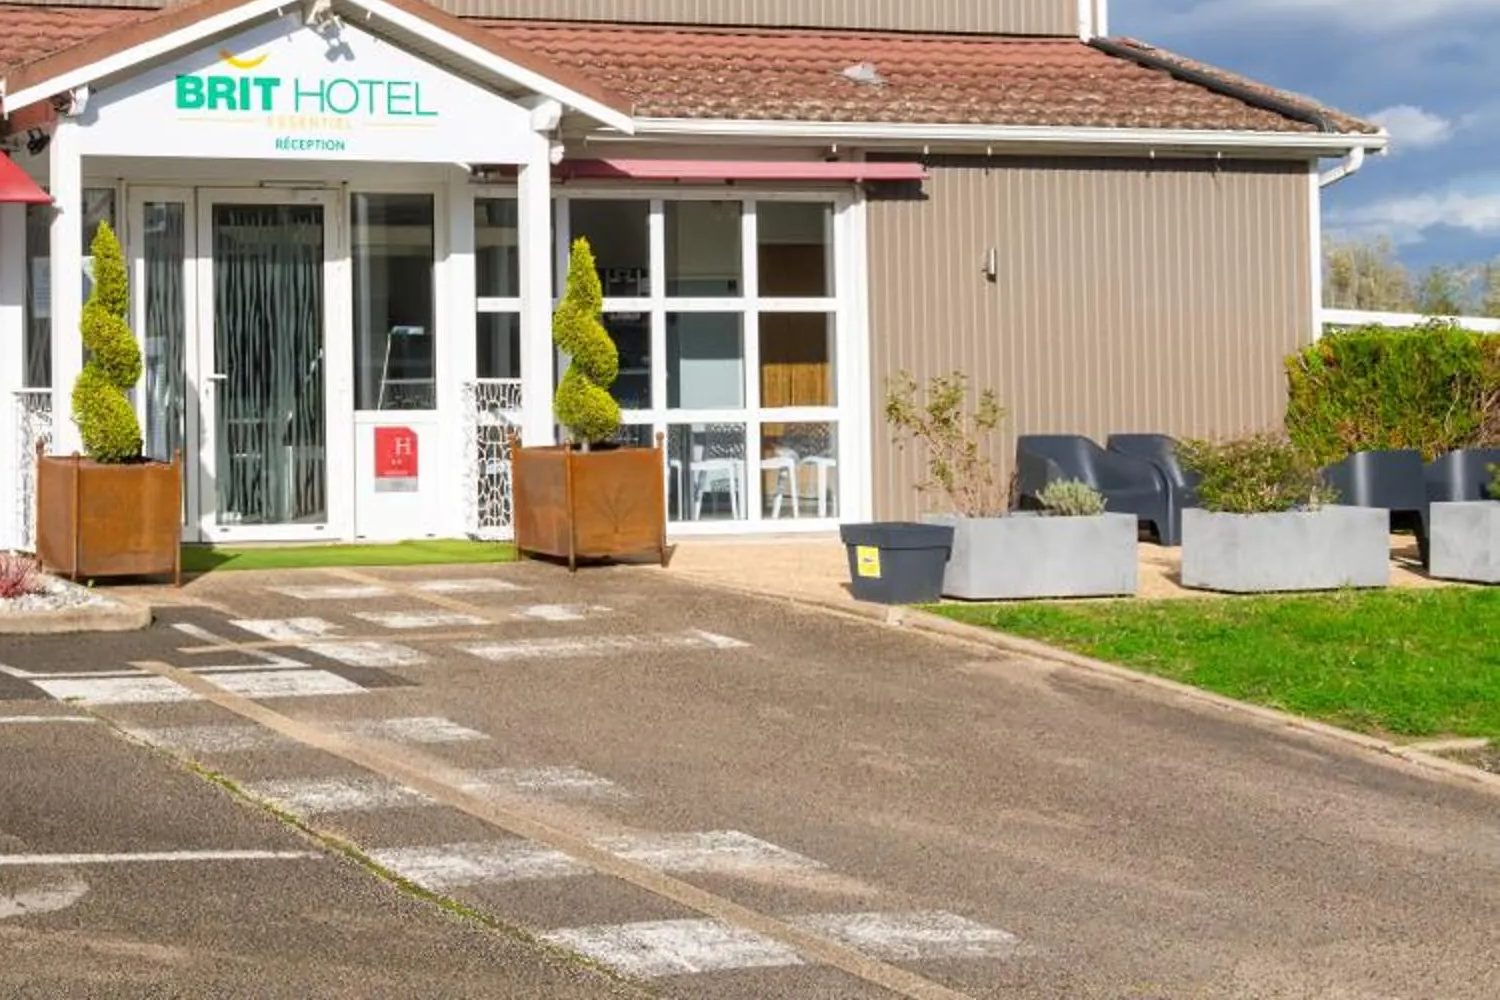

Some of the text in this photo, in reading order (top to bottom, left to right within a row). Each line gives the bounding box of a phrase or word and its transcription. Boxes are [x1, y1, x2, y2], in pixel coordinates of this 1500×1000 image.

[175, 75, 438, 116] BRIT HOTEL
[275, 136, 346, 151] RÉCEPTION
